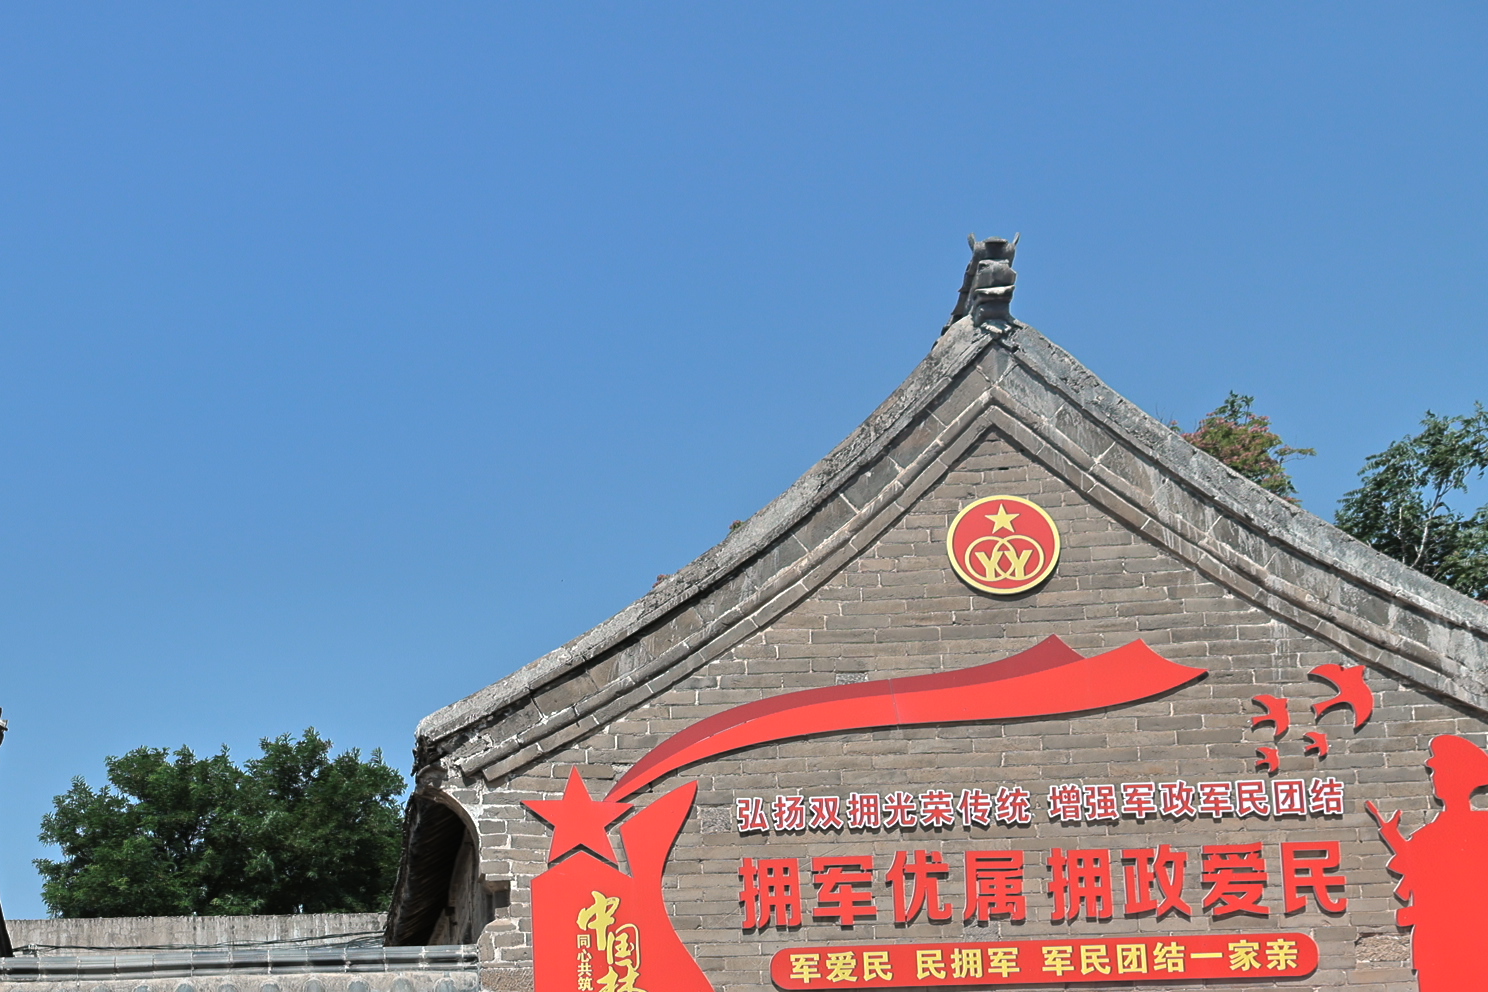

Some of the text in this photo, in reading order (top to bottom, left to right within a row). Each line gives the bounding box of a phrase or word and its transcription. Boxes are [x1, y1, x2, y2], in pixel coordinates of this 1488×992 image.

[735, 777, 1345, 832] 弘扬双拥光荣传统 增强军政军民团结
[739, 840, 1349, 930] 拥军优属 拥政爱民
[576, 933, 594, 992] 同心共筑
[789, 935, 1300, 984] 军爱民 民拥军 军民团结一家亲
